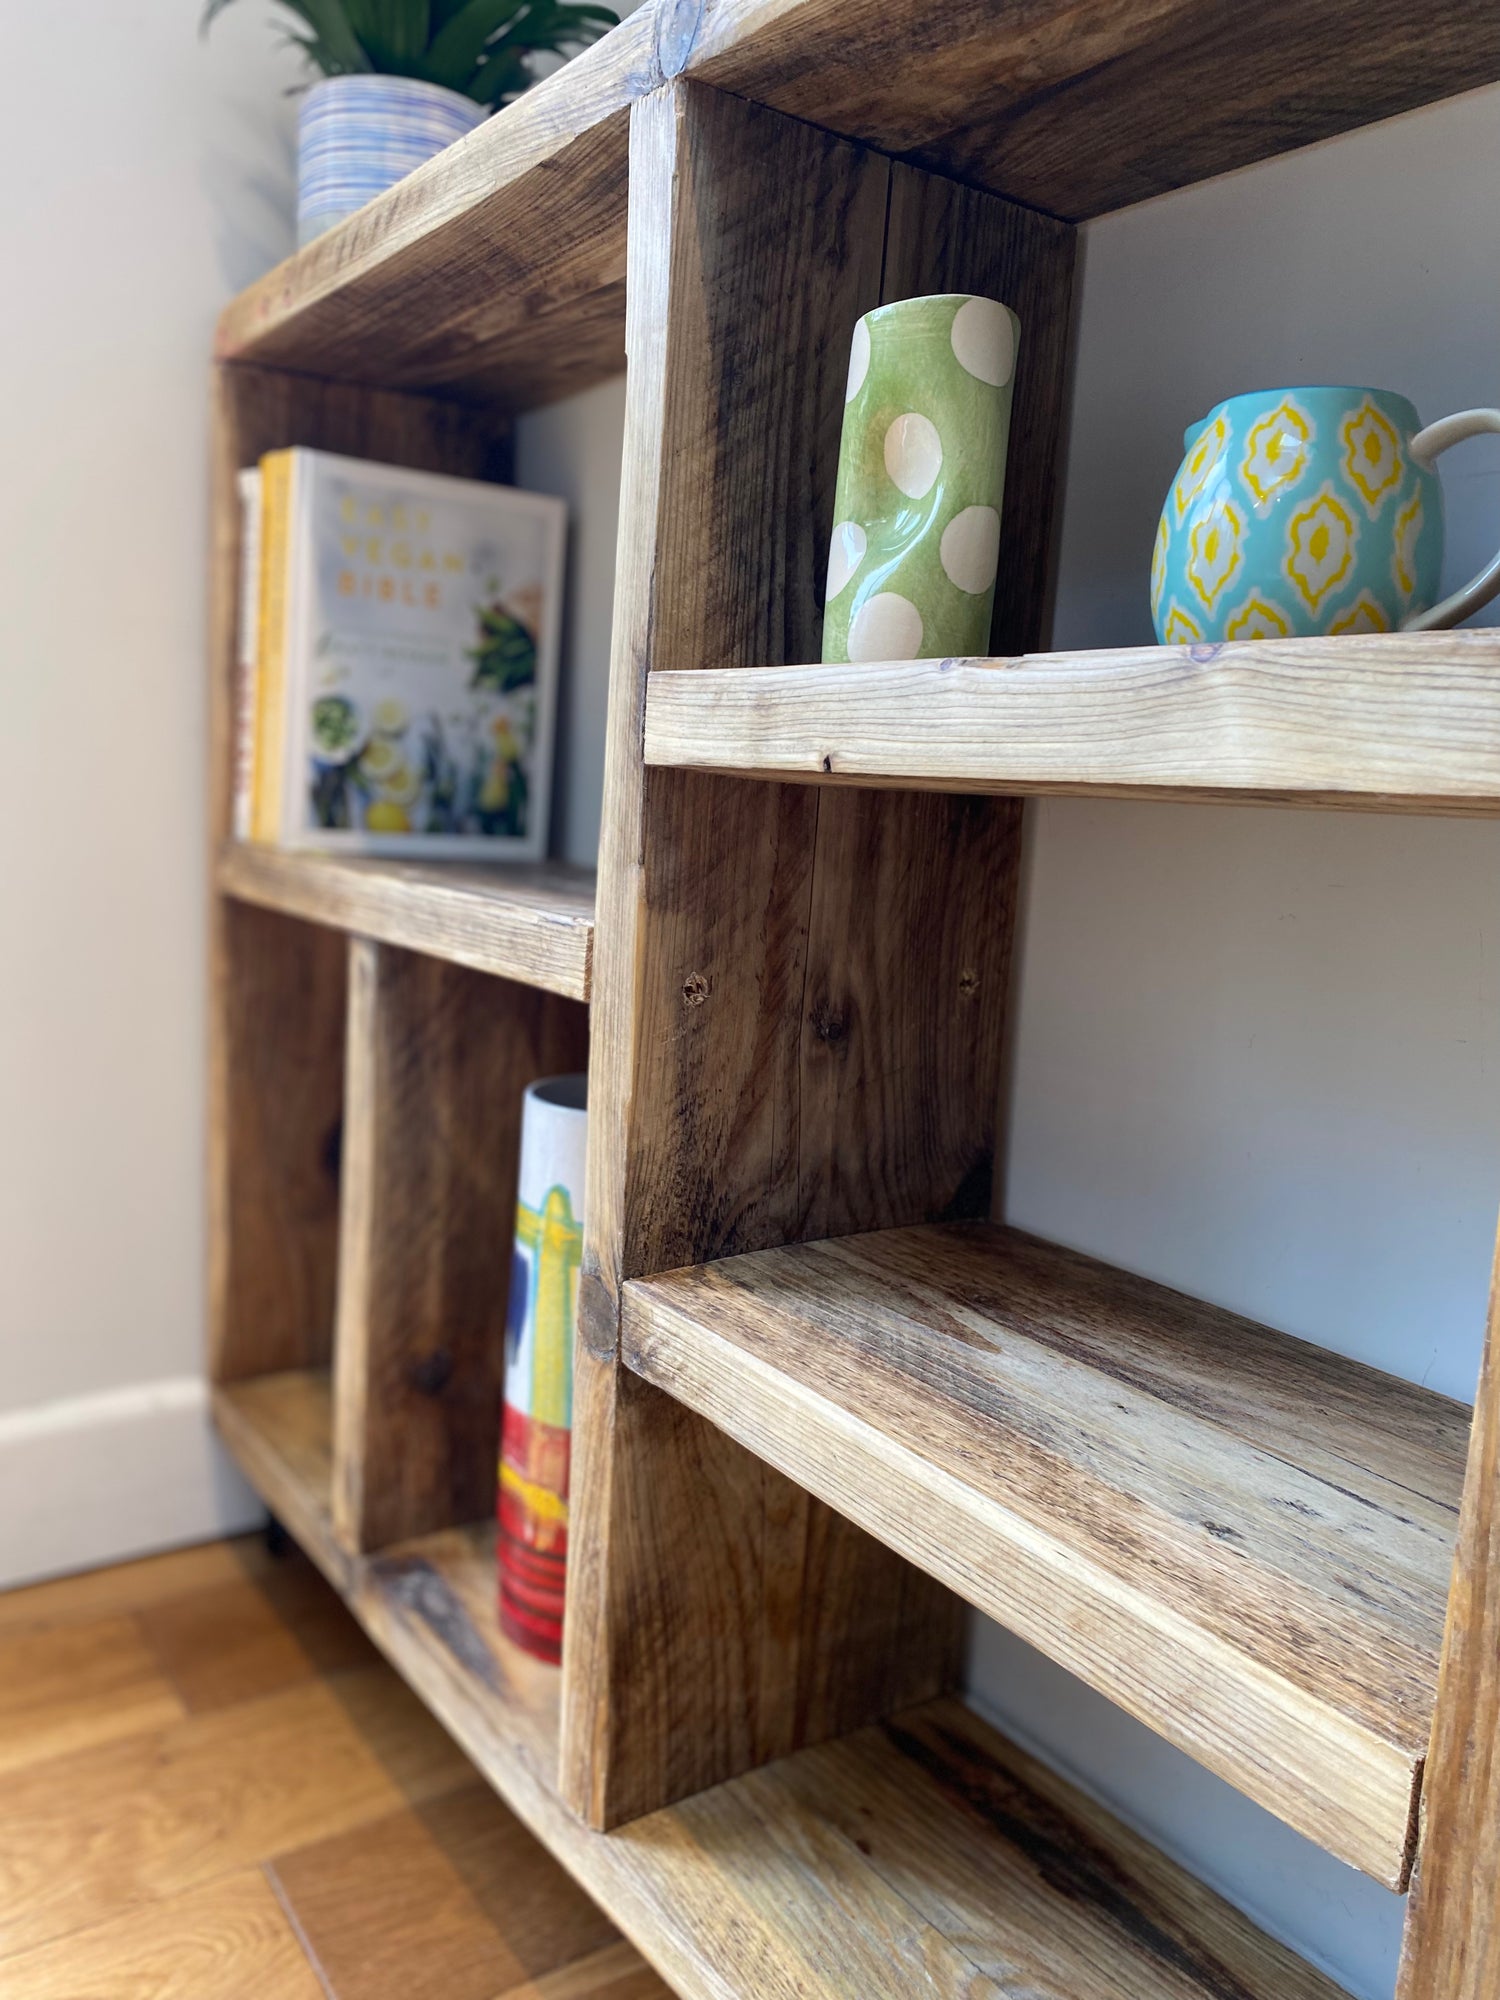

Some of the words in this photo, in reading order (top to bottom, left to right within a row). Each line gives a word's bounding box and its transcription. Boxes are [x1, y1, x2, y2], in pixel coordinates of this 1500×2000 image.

[341, 496, 430, 532] EASY
[341, 536, 464, 574] VEGAN
[339, 570, 441, 609] BIBLE
